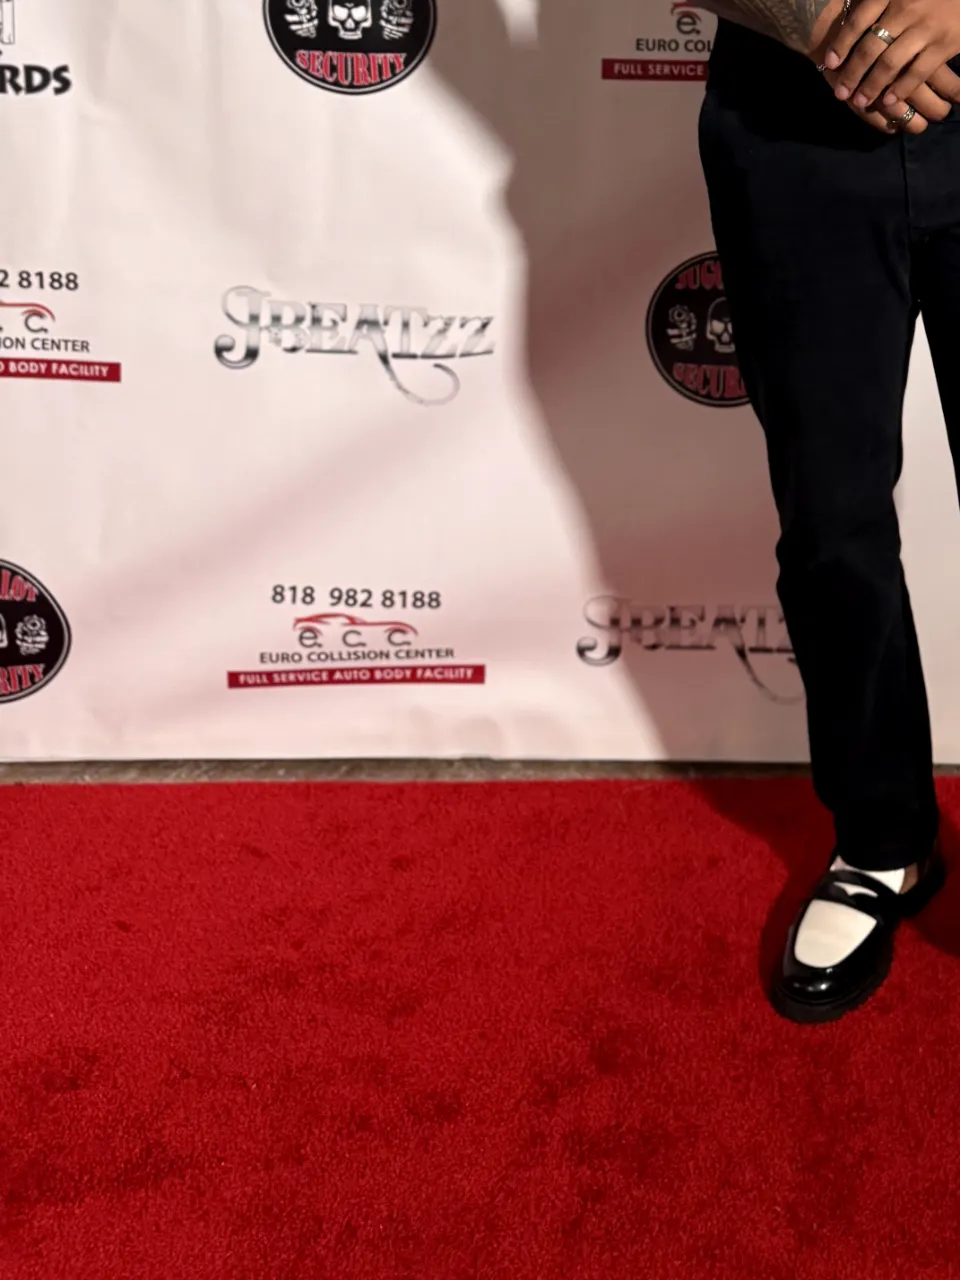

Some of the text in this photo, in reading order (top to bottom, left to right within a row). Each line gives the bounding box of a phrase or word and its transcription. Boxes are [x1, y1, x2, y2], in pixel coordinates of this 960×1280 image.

[636, 38, 679, 52] EURO
[295, 49, 407, 86] SECURITY
[614, 62, 704, 76] FULL SERVICE
[18, 270, 79, 291] 8188
[31, 337, 90, 353] CENTER
[214, 285, 495, 407] JBEATZZ
[9, 361, 47, 374] BODY
[52, 363, 109, 377] FACILITY
[271, 584, 441, 609] 818 982 8188
[260, 648, 455, 664] EURO COLLISION CENTER
[239, 667, 474, 686] FULL SERVICE AUTO BODY FACILITY
